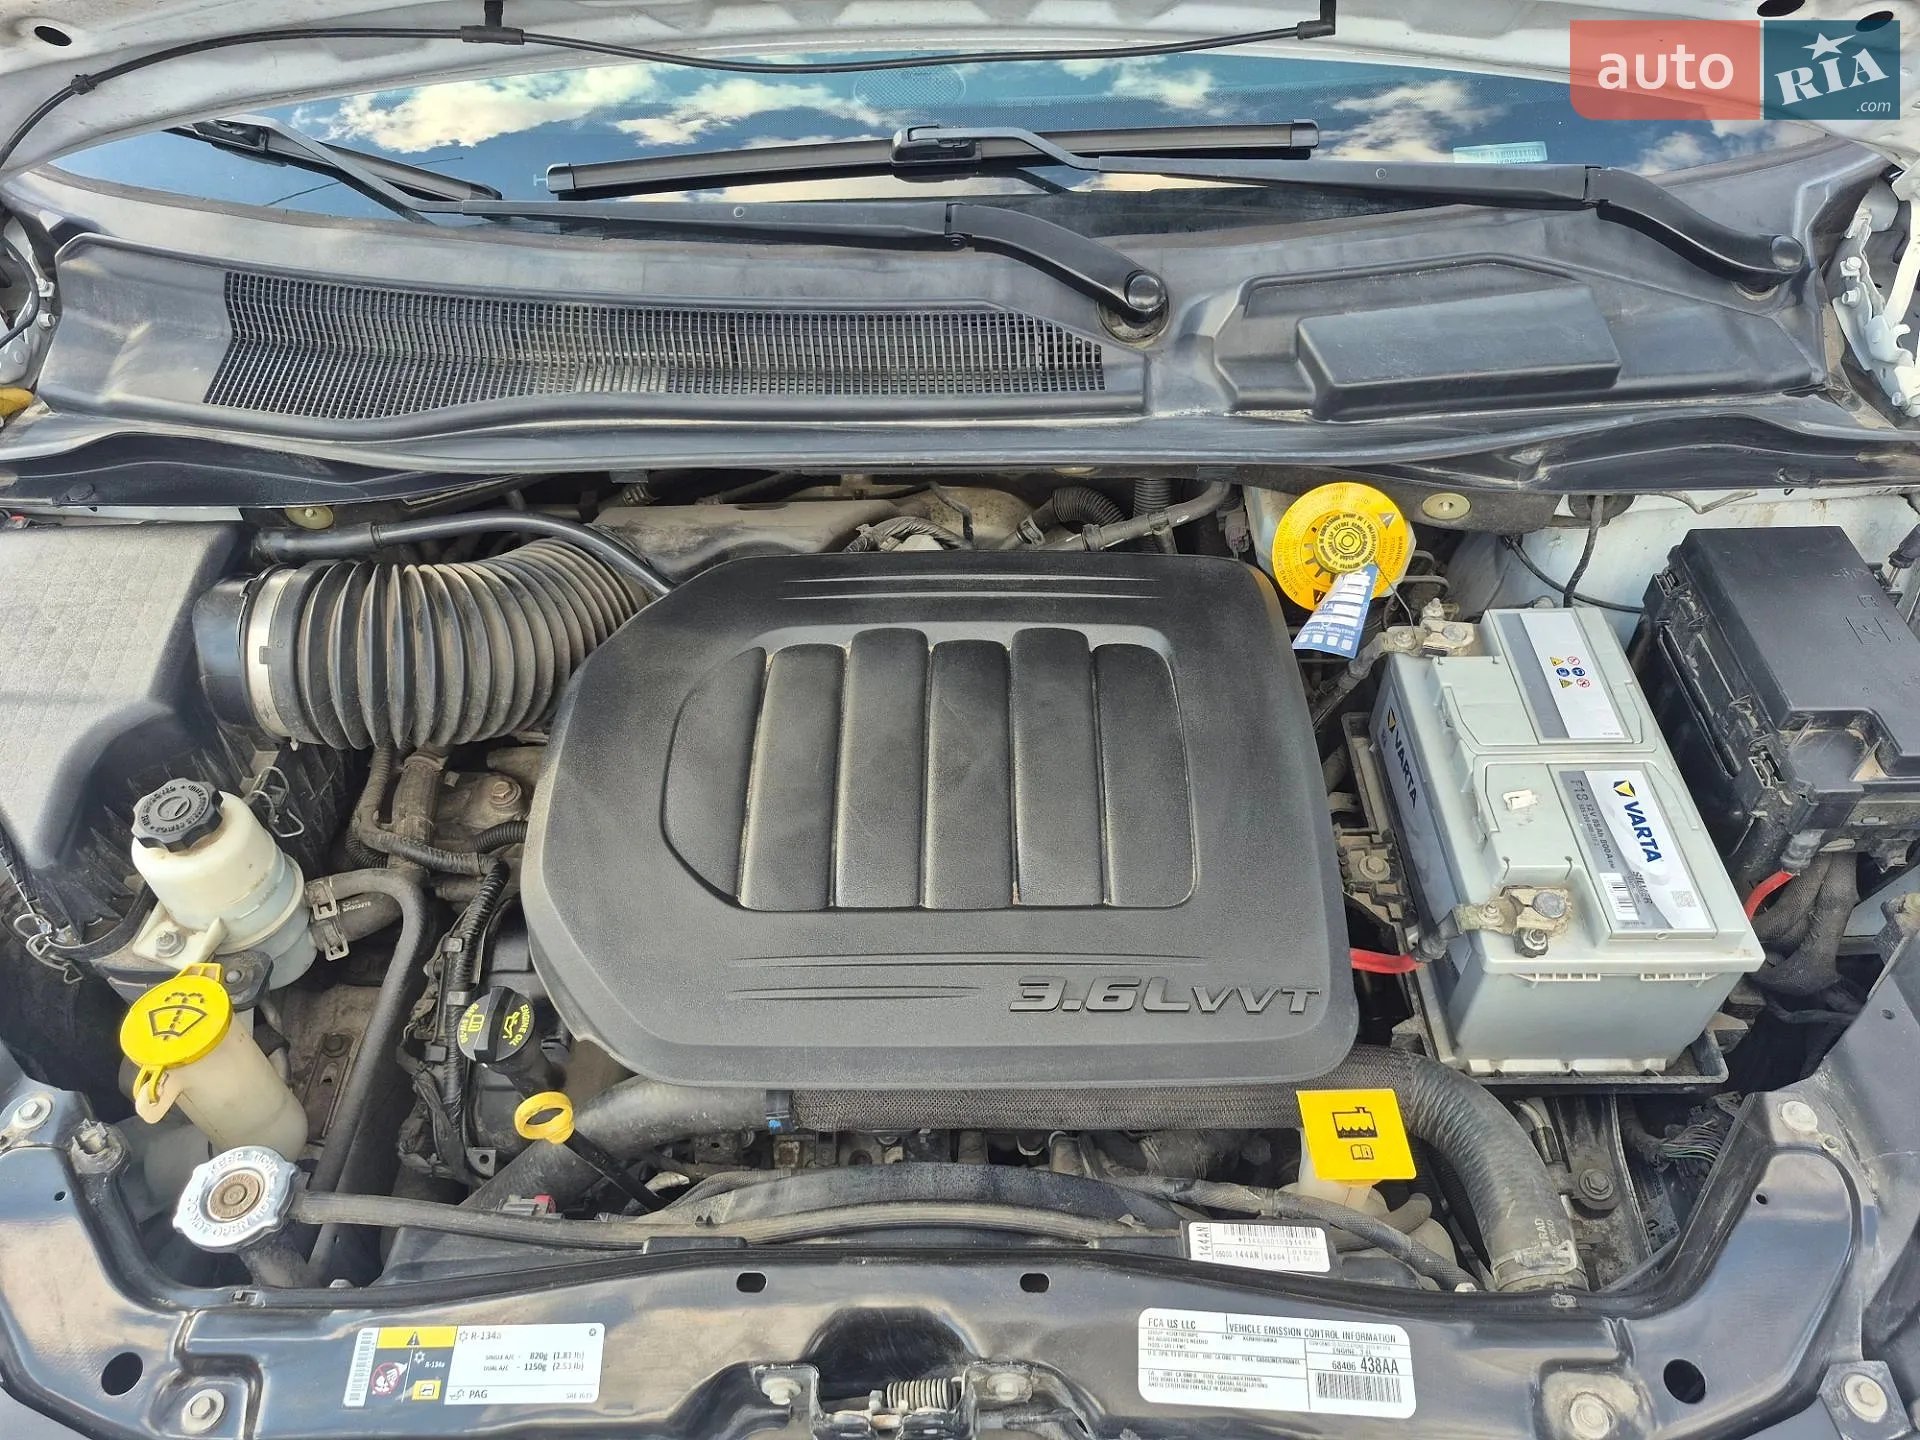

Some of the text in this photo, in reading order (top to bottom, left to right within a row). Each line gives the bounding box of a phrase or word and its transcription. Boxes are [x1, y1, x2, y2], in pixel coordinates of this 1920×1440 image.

[1395, 737, 1418, 809] VARTA
[1569, 779, 1590, 801] F18
[1623, 801, 1664, 864] VARTA
[508, 1003, 530, 1046] ENGINE OIL
[209, 1151, 244, 1174] KEEP
[1148, 1318, 1196, 1330] FCA US LLC
[1229, 1323, 1396, 1344] VEHICLE EMISSION CONTROL INFORMATION
[471, 1331, 502, 1340] R-134a
[529, 1352, 548, 1362] 820g
[1332, 1357, 1399, 1374] 68406 438AA
[524, 1362, 547, 1372] 1150g
[468, 1390, 488, 1399] PAG
